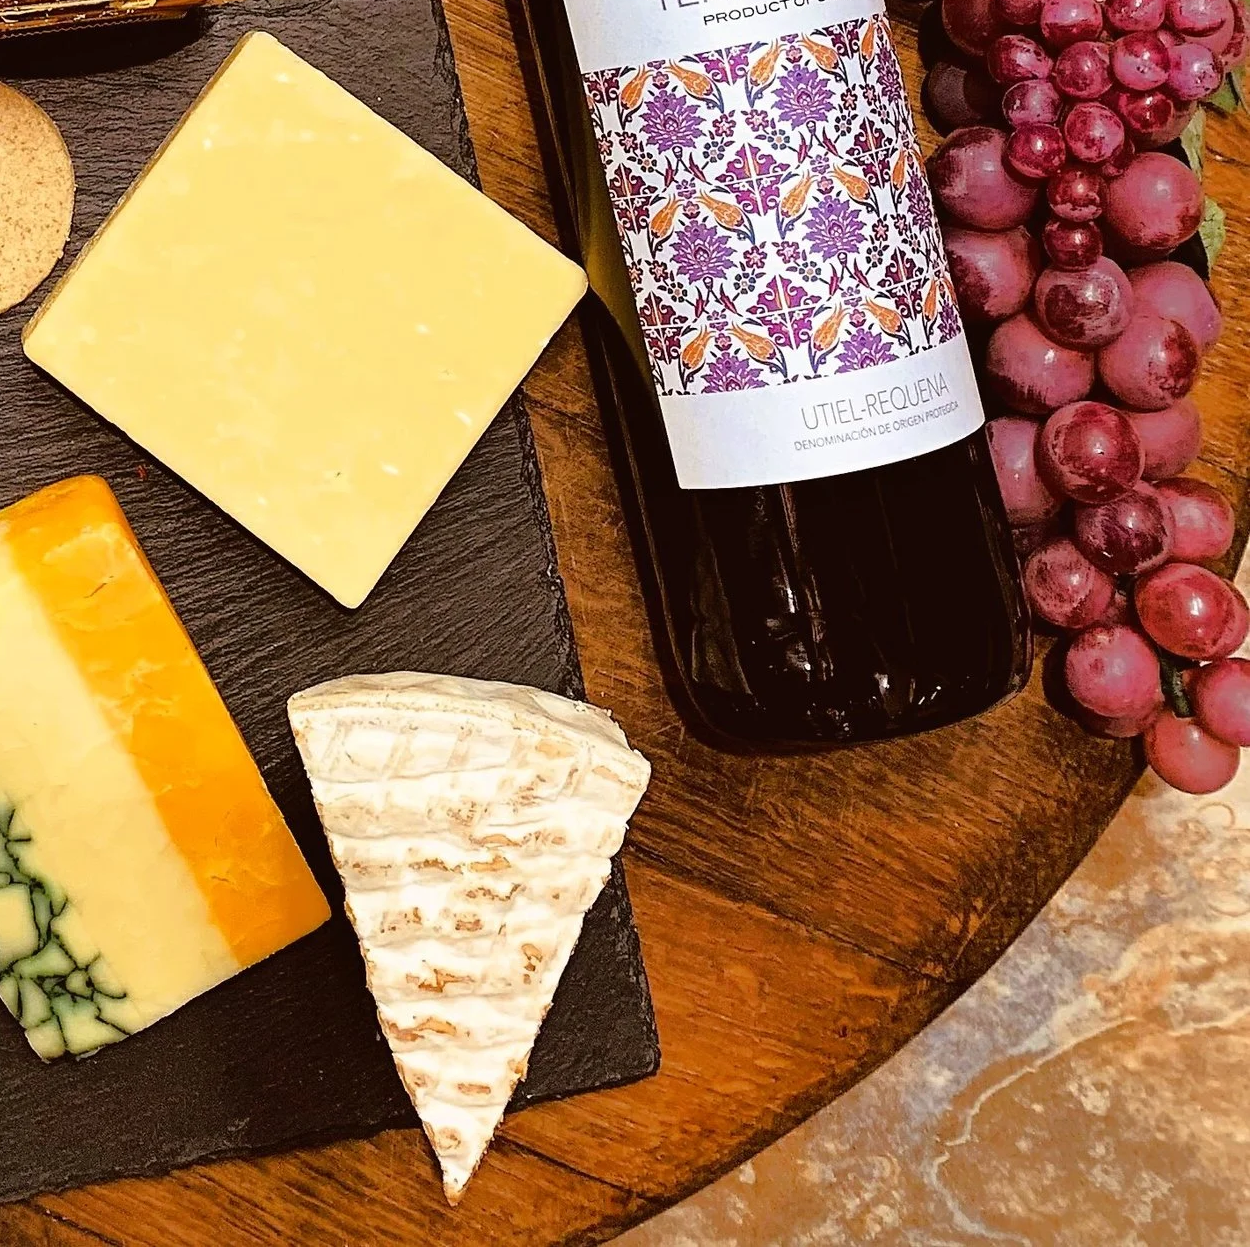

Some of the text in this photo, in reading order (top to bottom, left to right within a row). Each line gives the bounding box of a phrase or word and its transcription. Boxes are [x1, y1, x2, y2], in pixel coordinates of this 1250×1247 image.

[703, 0, 790, 26] PRODUCT
[801, 372, 950, 430] UTIEL-REQUENA
[794, 427, 877, 451] DENOMINACIÓN
[878, 422, 891, 435] DE
[892, 412, 924, 431] ORIGEN
